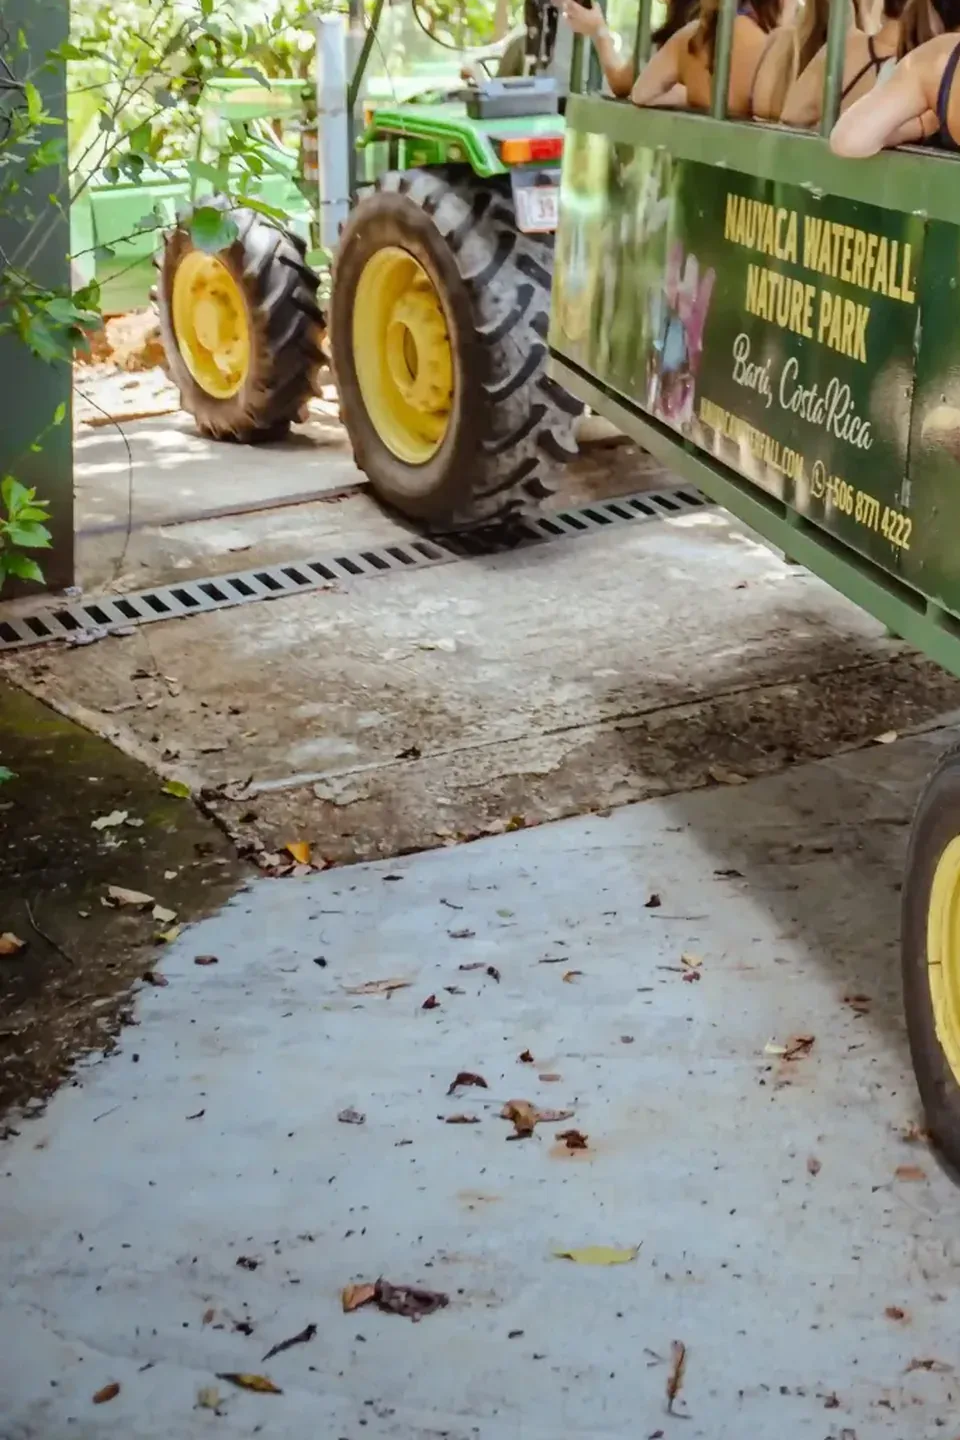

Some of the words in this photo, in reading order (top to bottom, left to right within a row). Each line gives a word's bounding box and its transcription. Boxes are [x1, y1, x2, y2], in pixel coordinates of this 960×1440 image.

[724, 192, 797, 264] NAUYACA
[803, 215, 916, 304] WATERFALL
[745, 263, 816, 339] NATURE
[817, 290, 871, 364] PARK
[779, 357, 826, 425] Costa
[825, 377, 874, 450] Rica
[825, 475, 854, 516] +506
[881, 506, 912, 550] 4222
